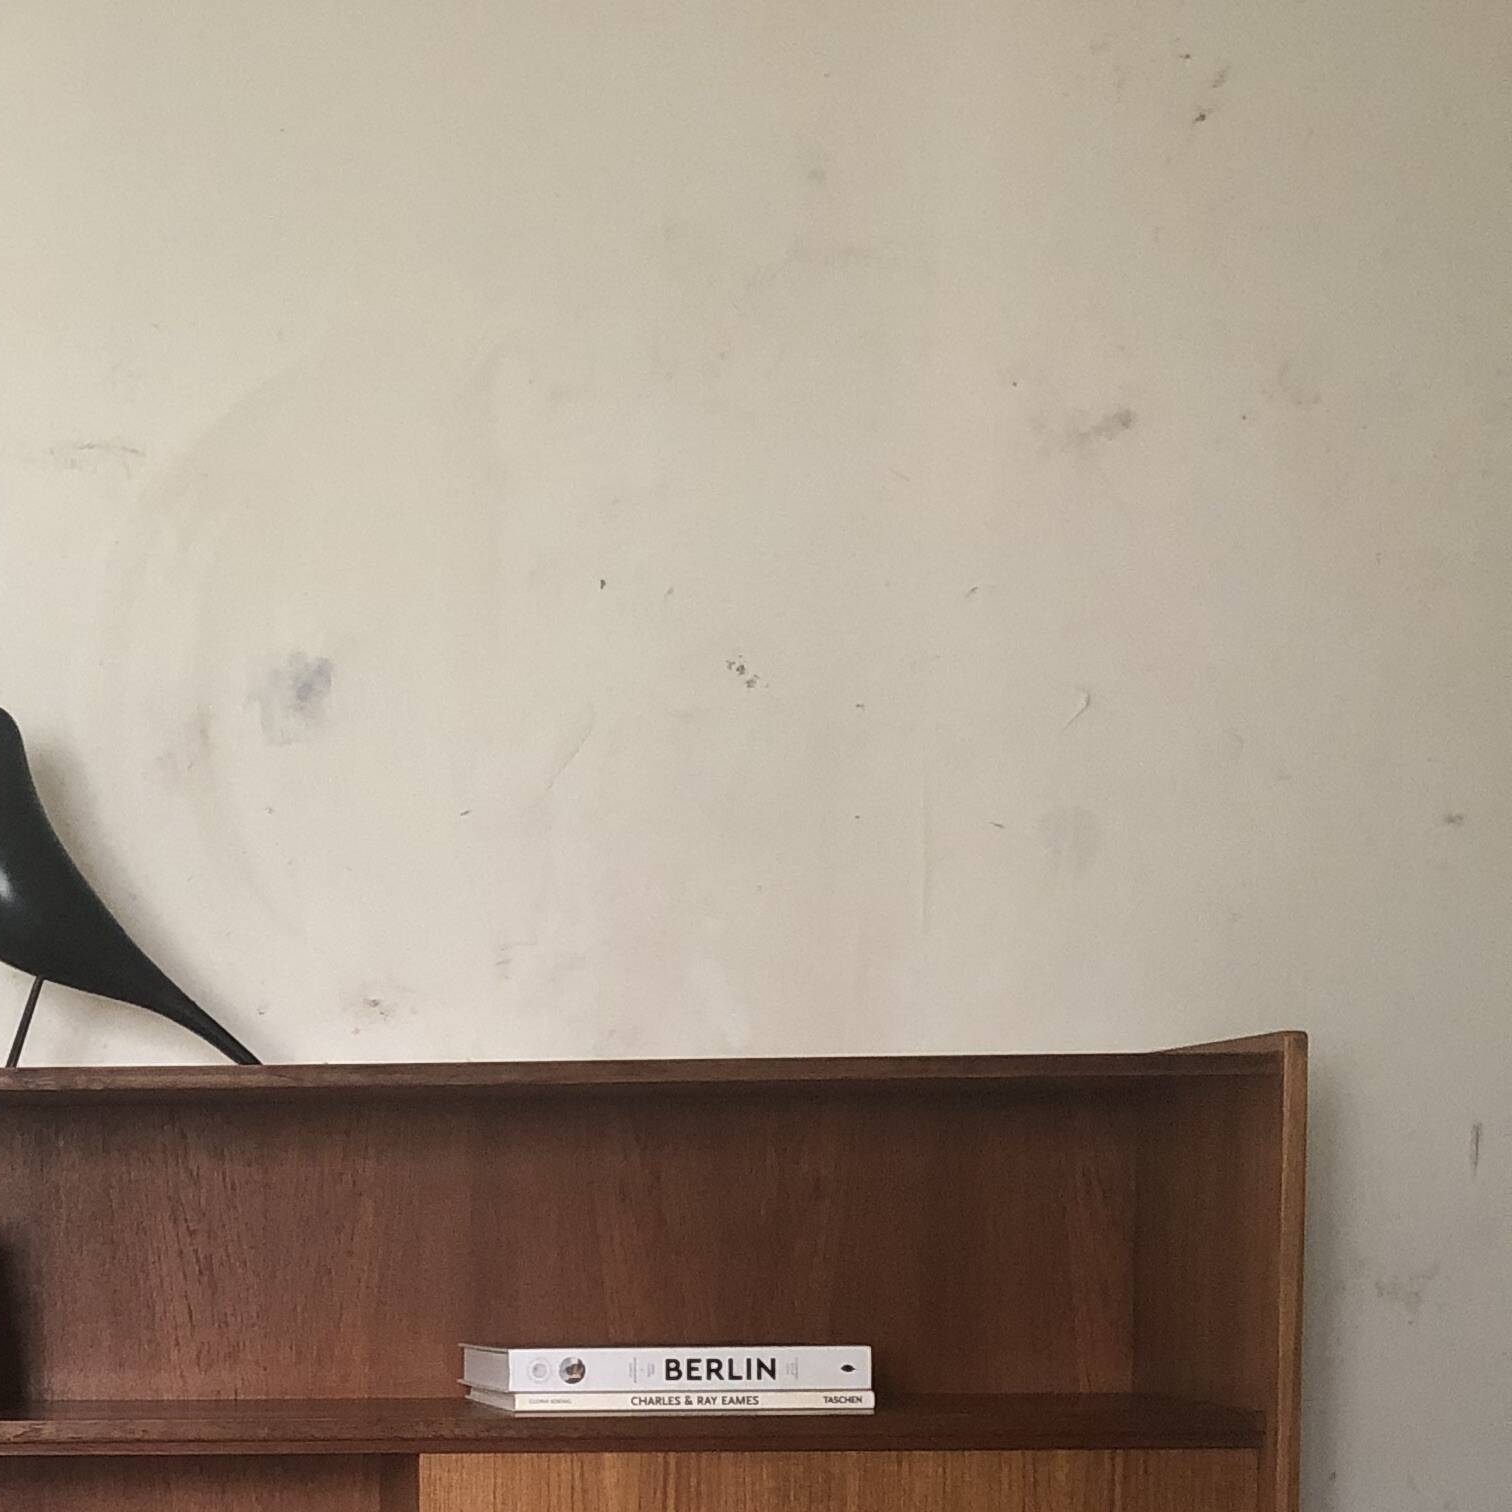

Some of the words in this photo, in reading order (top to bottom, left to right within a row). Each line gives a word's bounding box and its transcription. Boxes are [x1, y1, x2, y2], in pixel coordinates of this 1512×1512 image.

[665, 1356, 776, 1381] BERLIN
[630, 1395, 681, 1406] CHARLES
[684, 1395, 692, 1405] &
[696, 1394, 717, 1405] RAY
[721, 1393, 759, 1405] EAMES
[823, 1394, 863, 1404] TASCHEN
